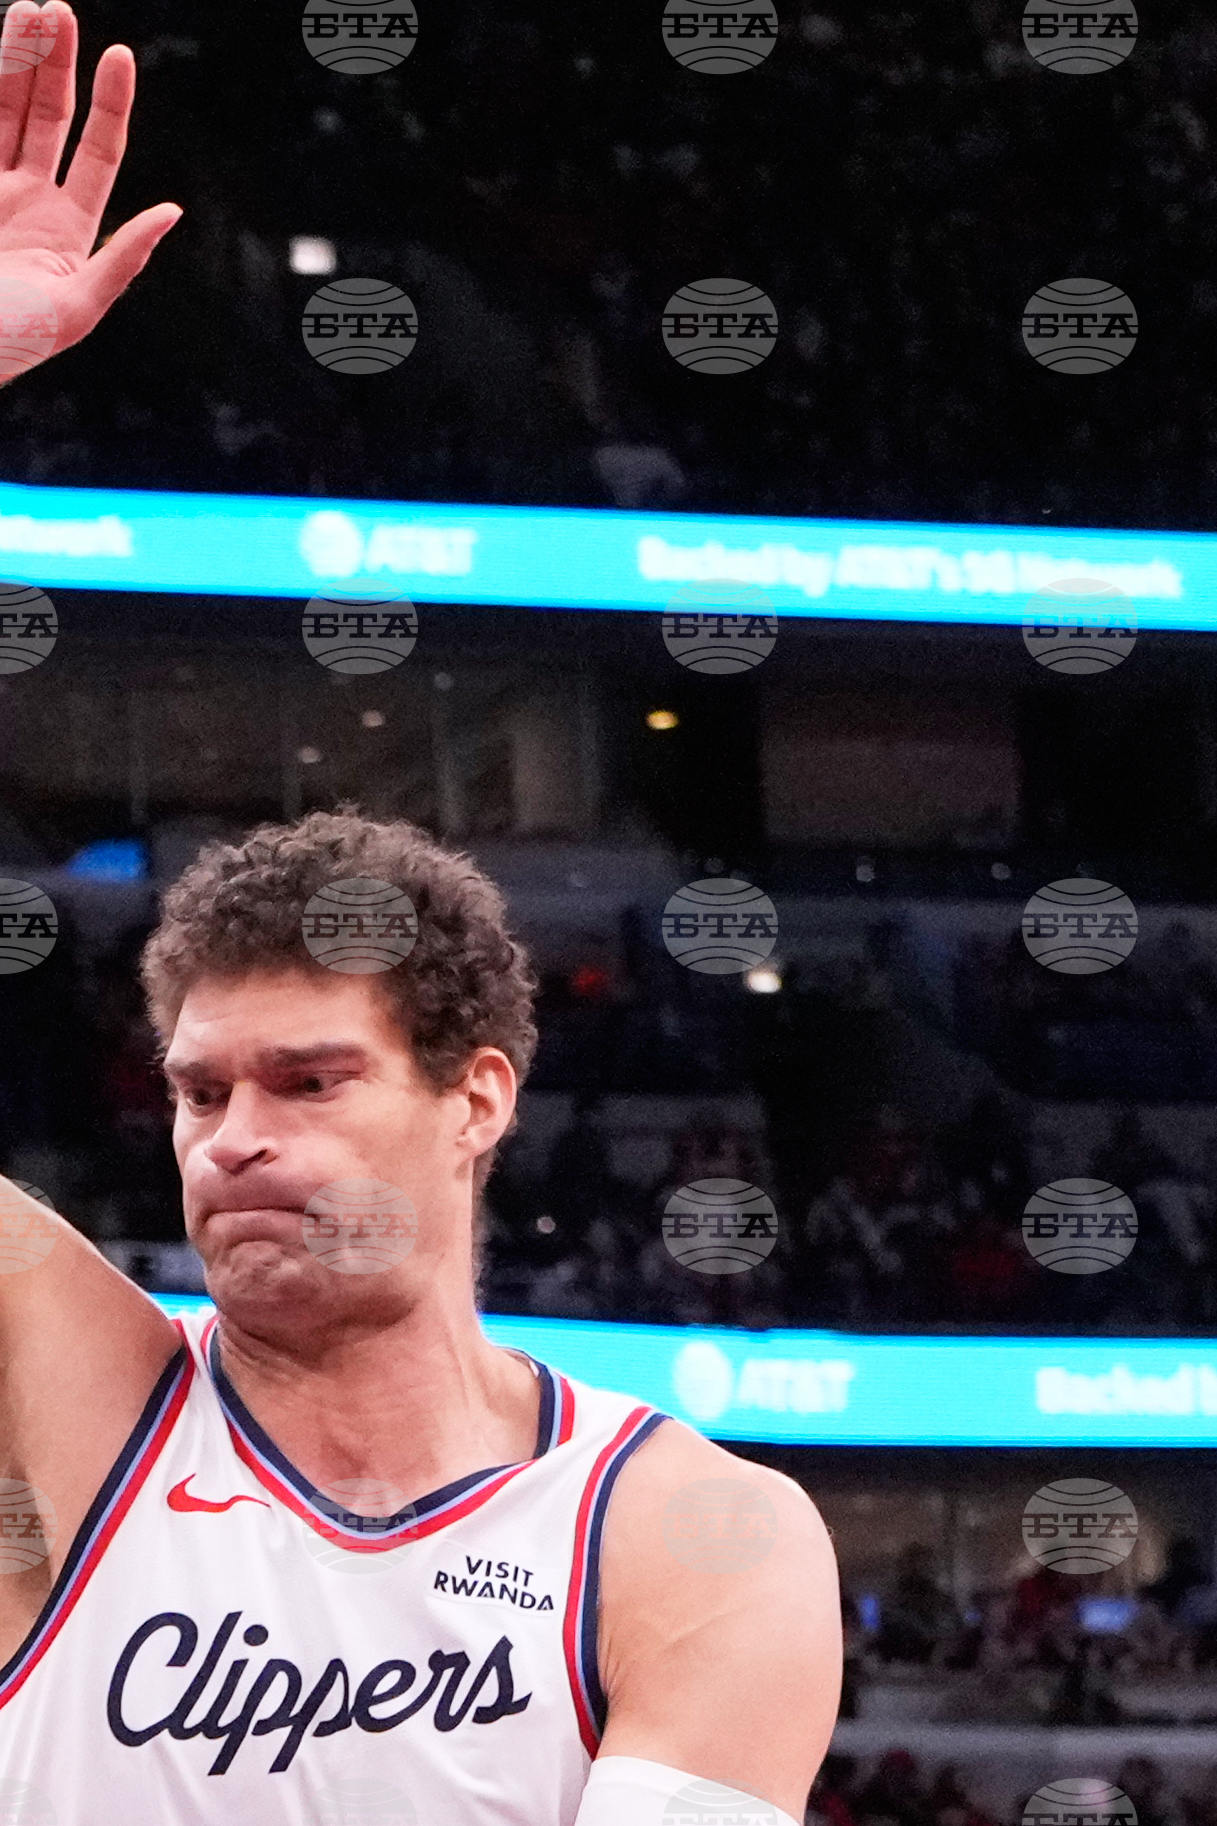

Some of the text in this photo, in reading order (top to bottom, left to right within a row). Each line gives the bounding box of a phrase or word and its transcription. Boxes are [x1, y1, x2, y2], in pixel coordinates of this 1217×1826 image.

[433, 1570, 554, 1611] RWANDA
[465, 1555, 534, 1587] VISIT
[106, 1610, 533, 1776] Clippers
